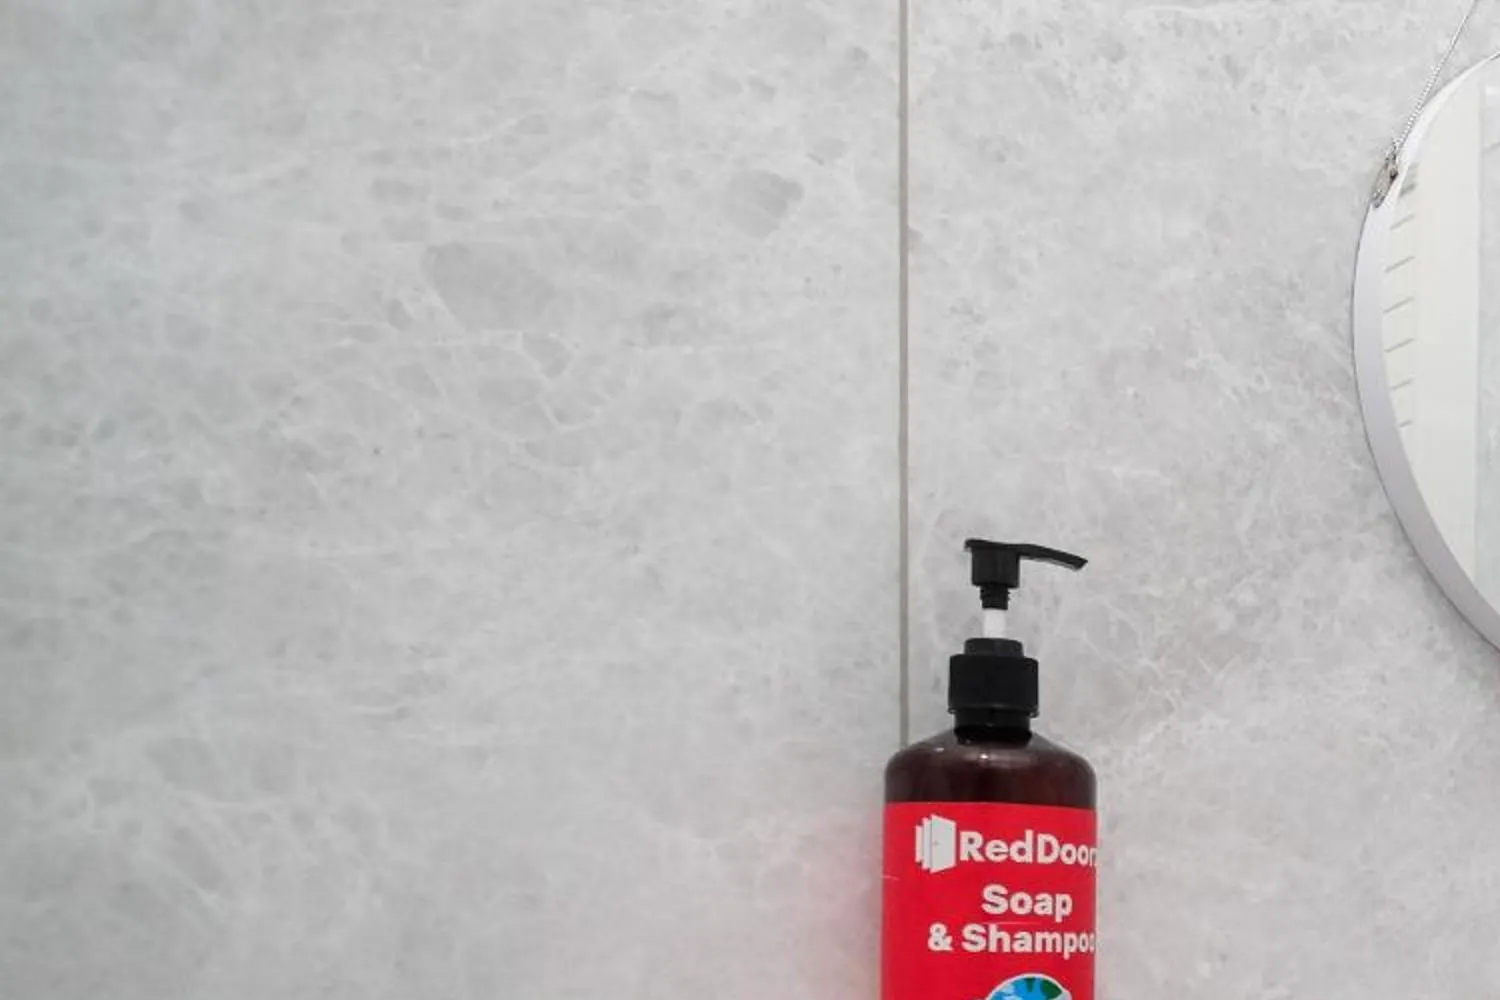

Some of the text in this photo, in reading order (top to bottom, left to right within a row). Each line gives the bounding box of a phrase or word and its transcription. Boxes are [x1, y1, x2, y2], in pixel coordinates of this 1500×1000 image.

[959, 829, 1099, 867] RedDoor
[981, 884, 1073, 923] Soap
[927, 923, 953, 952] &
